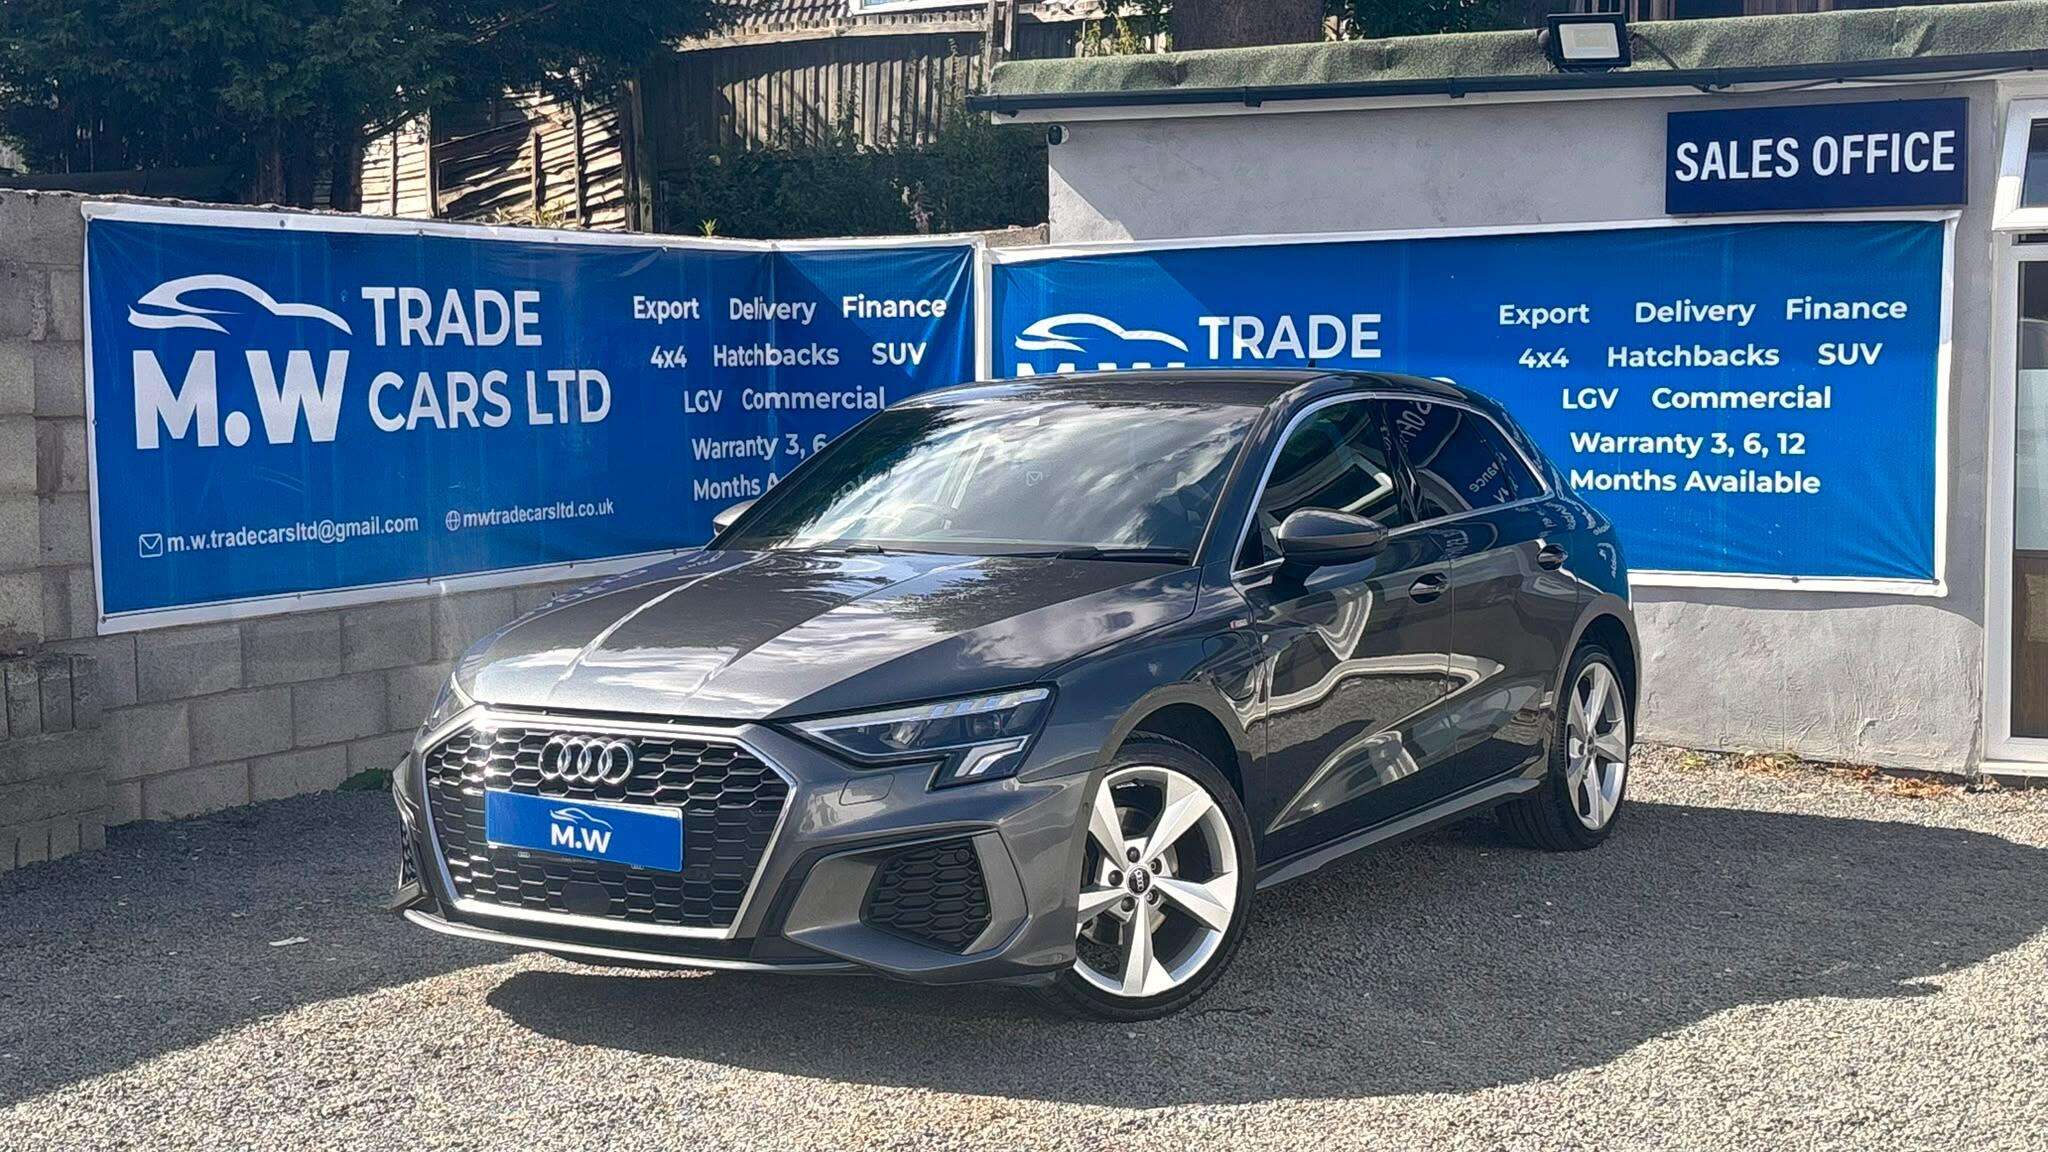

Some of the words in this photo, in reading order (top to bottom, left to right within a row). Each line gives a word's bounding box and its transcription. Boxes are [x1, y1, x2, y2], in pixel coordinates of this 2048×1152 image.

[1675, 137, 1800, 182] SALES
[1812, 130, 1955, 176] OFFICE
[361, 286, 543, 347] TRADE
[633, 295, 700, 325] Export
[729, 295, 817, 326] Delivery
[842, 293, 947, 318] Finance
[1499, 303, 1590, 330] Export
[1635, 299, 1757, 326] Delivery
[1786, 295, 1908, 321] Finance
[1198, 313, 1382, 360] TRADE
[650, 345, 688, 369] 4x4
[713, 342, 840, 367] Hatchbacks
[872, 341, 927, 366] SUV
[1518, 347, 1570, 369] 4x4
[1607, 343, 1780, 368] Hatchbacks
[1817, 342, 1883, 366] SUV
[132, 349, 350, 450] M.W
[368, 370, 512, 431] CARS
[526, 368, 611, 425] LTD
[683, 389, 723, 413] LGV
[742, 386, 885, 410] Commercial
[1562, 387, 1619, 410] LGV
[1651, 384, 1831, 409] Commercial
[691, 436, 779, 461] Warranty
[785, 433, 806, 459] 3,
[1570, 431, 1703, 458] Warranty
[1710, 432, 1735, 458] 3,
[1743, 432, 1769, 458] 6,
[1776, 432, 1806, 455] 12
[693, 474, 761, 501] Months
[1570, 468, 1677, 492] Months
[1683, 468, 1821, 495] Available
[463, 497, 615, 528] mwtradecarsltd.co.uk
[167, 515, 419, 553] m.w.tradecarsltd@gmail.com
[551, 823, 611, 853] M.W
